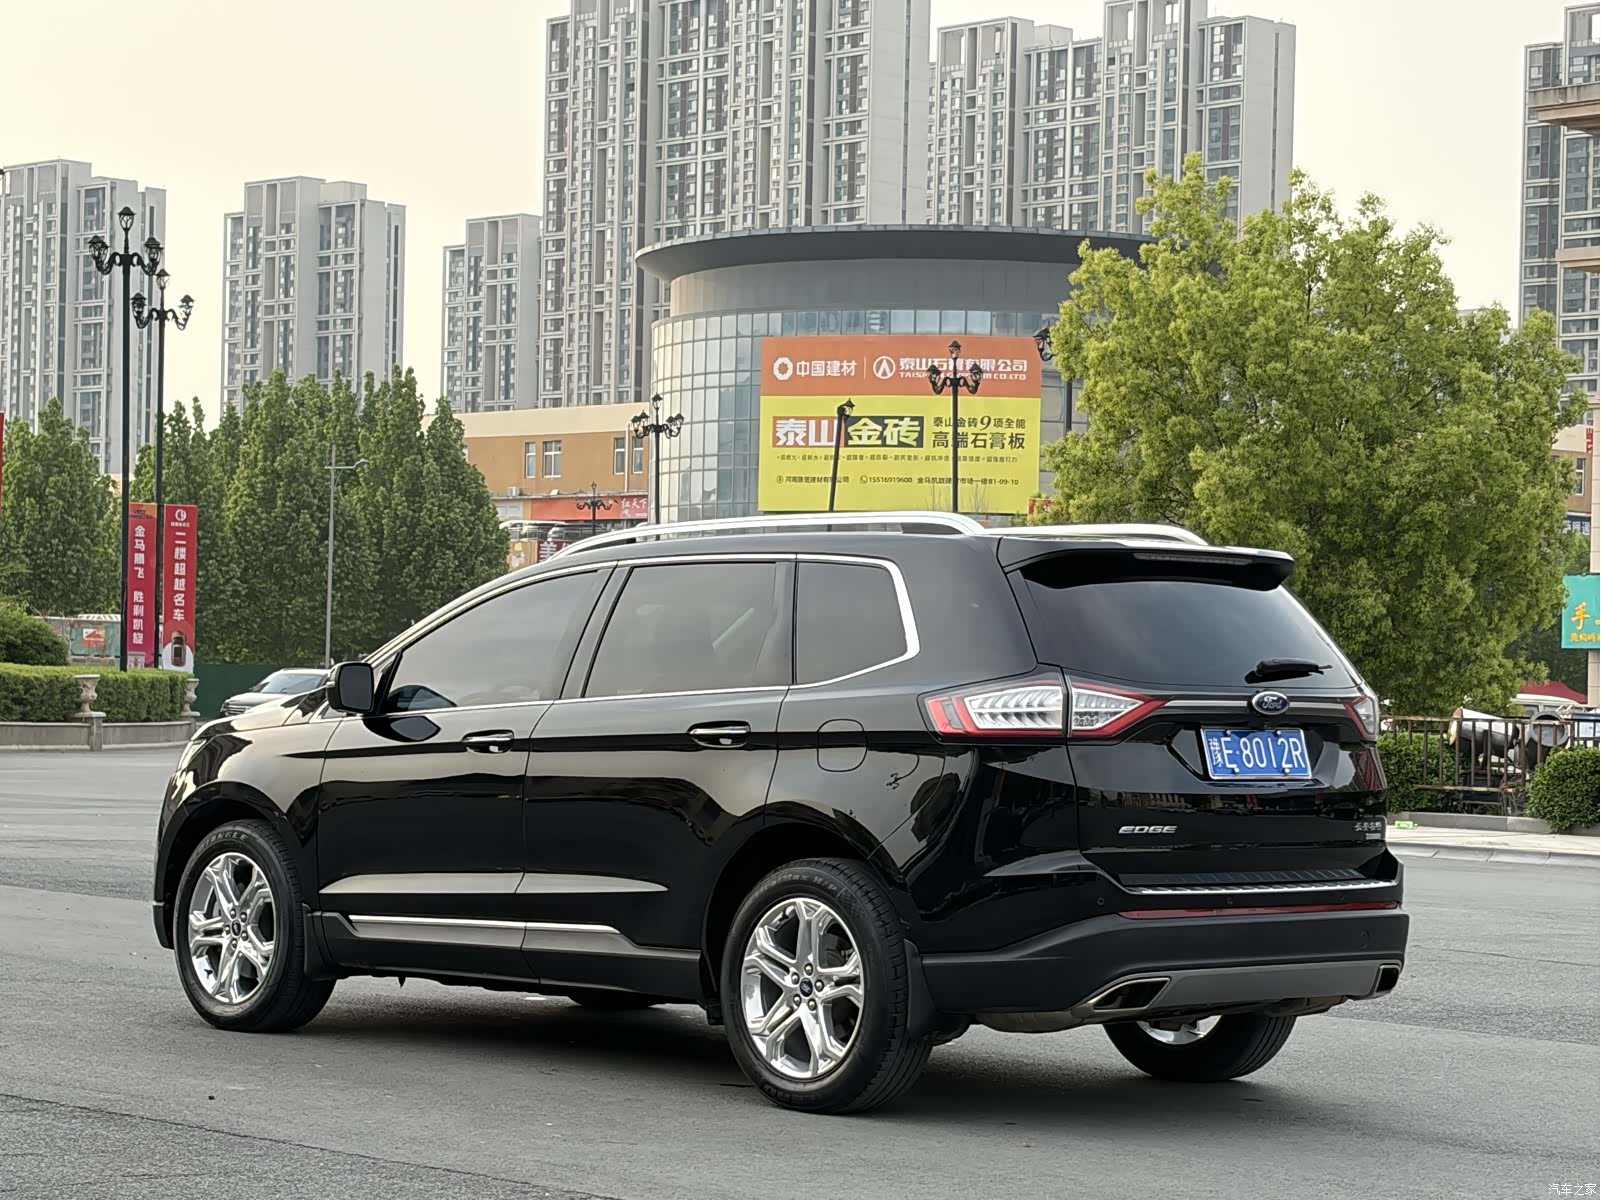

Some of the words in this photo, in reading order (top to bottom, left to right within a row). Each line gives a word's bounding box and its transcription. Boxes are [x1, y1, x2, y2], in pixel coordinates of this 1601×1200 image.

[796, 360, 857, 377] 中国建材
[775, 417, 921, 446] 泰山金砖
[932, 431, 1026, 449] 高端石膏板
[173, 531, 187, 621] 二楼超越名车
[133, 591, 145, 645] 胜利凯旋
[1262, 696, 1283, 709] Ford
[1118, 825, 1178, 834] EDGE
